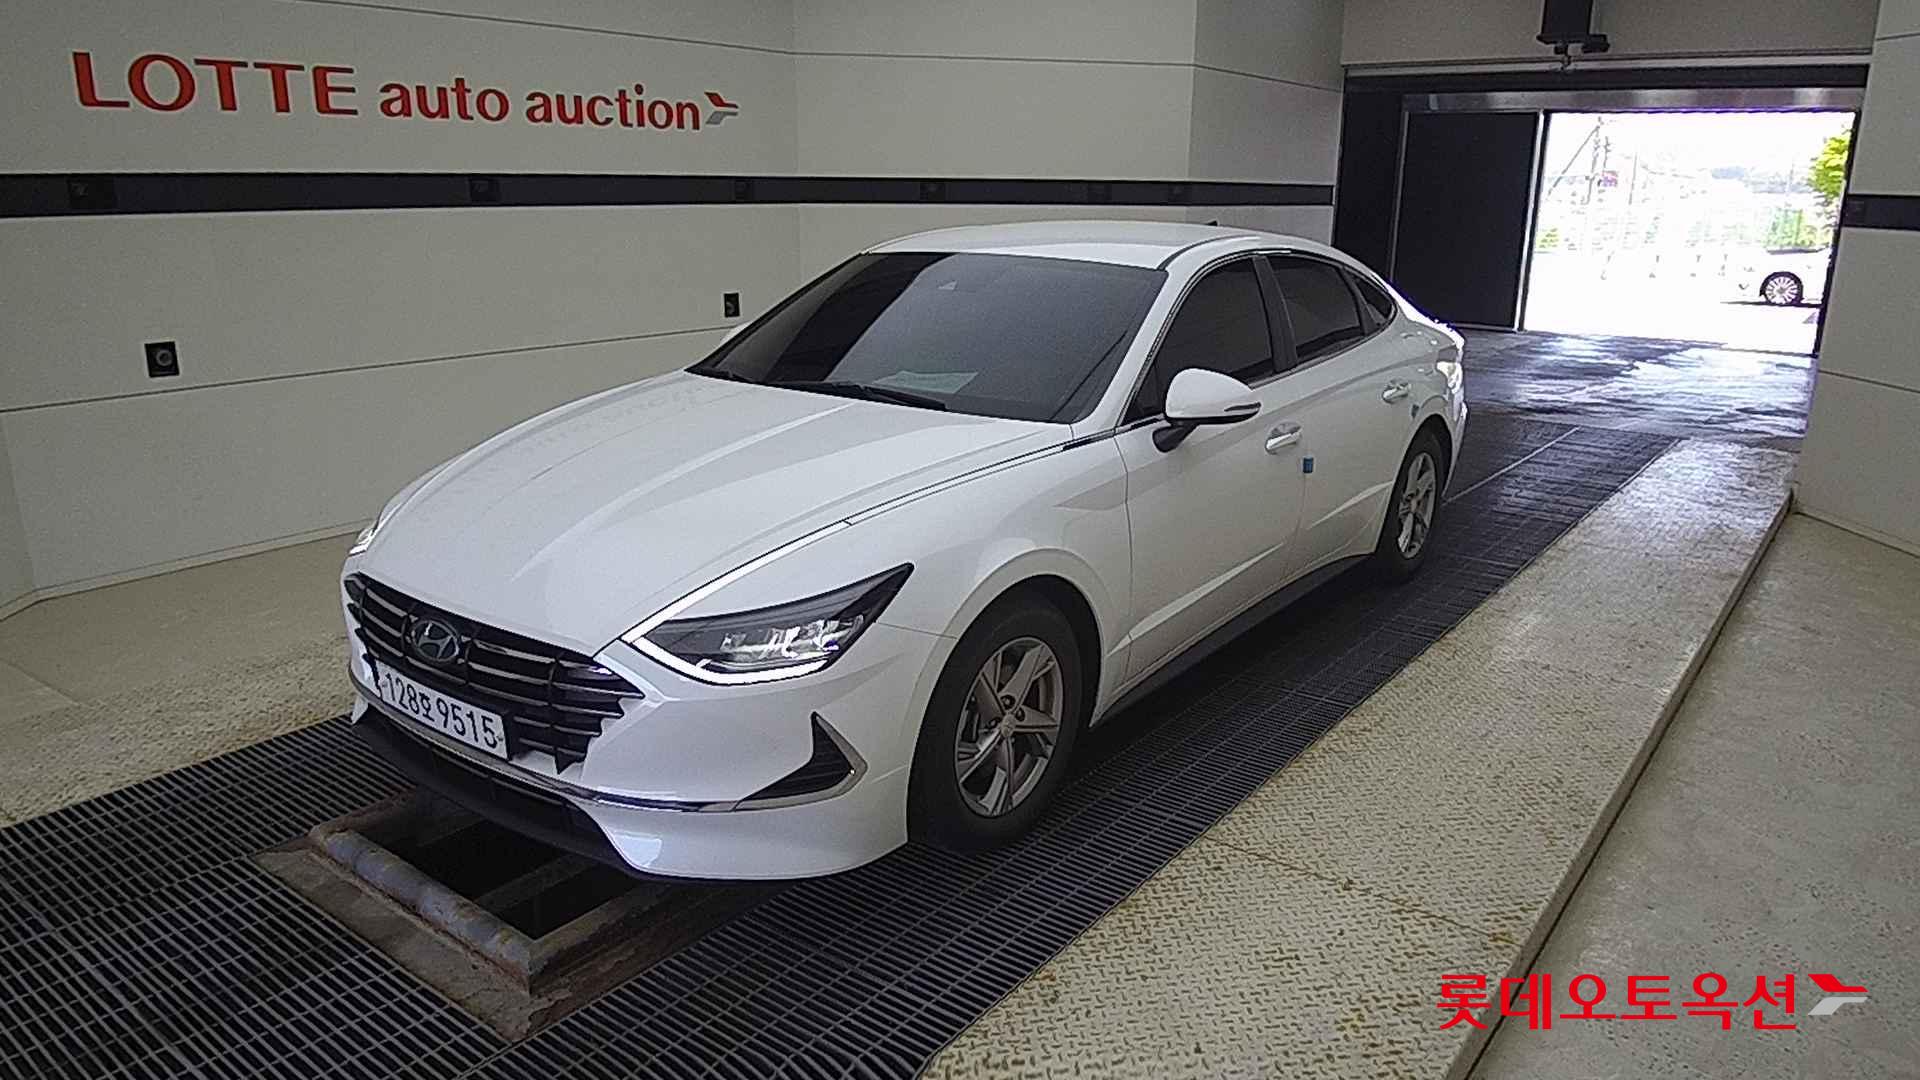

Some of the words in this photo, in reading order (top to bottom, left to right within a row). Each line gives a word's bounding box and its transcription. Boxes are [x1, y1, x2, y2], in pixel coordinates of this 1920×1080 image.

[72, 51, 359, 117] LOTTE
[379, 77, 511, 122] auto
[525, 85, 700, 131] auction
[436, 697, 498, 749] 9515
